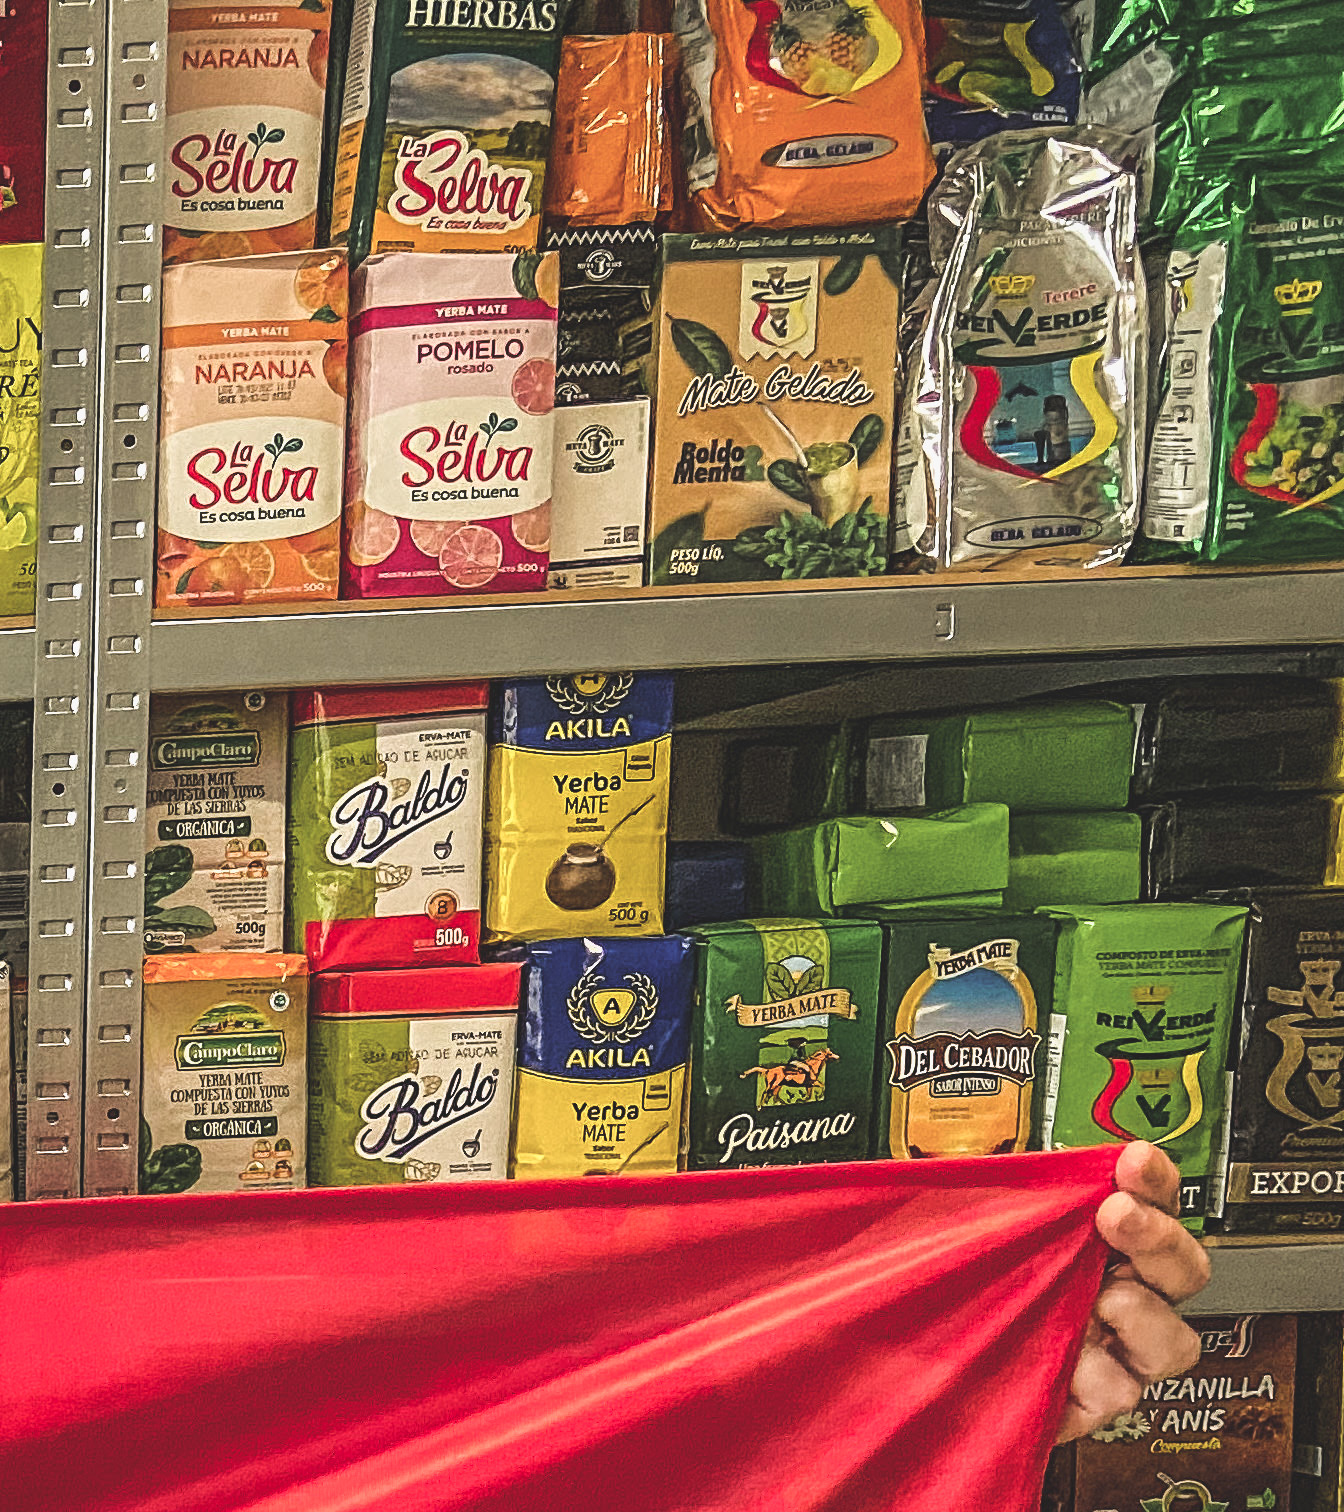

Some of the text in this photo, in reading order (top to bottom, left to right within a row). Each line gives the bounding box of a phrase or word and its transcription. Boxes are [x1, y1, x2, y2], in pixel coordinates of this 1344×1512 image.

[181, 46, 300, 71] NARANJA
[171, 133, 297, 199] Selva
[396, 140, 528, 220] Selva
[1042, 283, 1096, 305] Terere
[417, 338, 525, 364] POMELO
[195, 361, 316, 385] NARANJA
[447, 360, 494, 375] rosado
[678, 365, 876, 416] Mate Gelado
[400, 426, 534, 485] Selva
[679, 443, 746, 464] Boldo
[187, 448, 318, 509] Selva
[673, 461, 746, 484] Menta
[412, 484, 519, 502] Es cosa buena
[200, 507, 306, 524] Es cosa buena
[669, 561, 699, 575] 500g
[419, 731, 471, 742] ERVA-MATE
[545, 719, 631, 742] AKILA
[157, 743, 251, 764] CampoClaro
[553, 774, 621, 794] Yerba
[565, 795, 609, 815] MATE
[176, 819, 235, 837] ORGÁNICA
[236, 922, 265, 936] 500g
[435, 927, 469, 948] 500g
[934, 942, 1014, 978] YERBA MATE
[604, 998, 620, 1014] A
[752, 992, 838, 1024] YERBA MATE
[182, 1041, 279, 1066] CampoClaro
[566, 1047, 651, 1070] AKILA
[898, 1043, 1035, 1075] DEL CEBADOR
[199, 1072, 263, 1088] YERBA MATE
[936, 1077, 997, 1091] SABOR INTENSO
[170, 1084, 290, 1103] COMPUESTA CON YUYOS
[573, 1101, 639, 1122] Yerba
[203, 1118, 263, 1137] ORGÁNICA
[582, 1122, 626, 1143] MATE
[718, 1111, 855, 1164] Paisana
[1162, 1404, 1226, 1433] ANÍS
